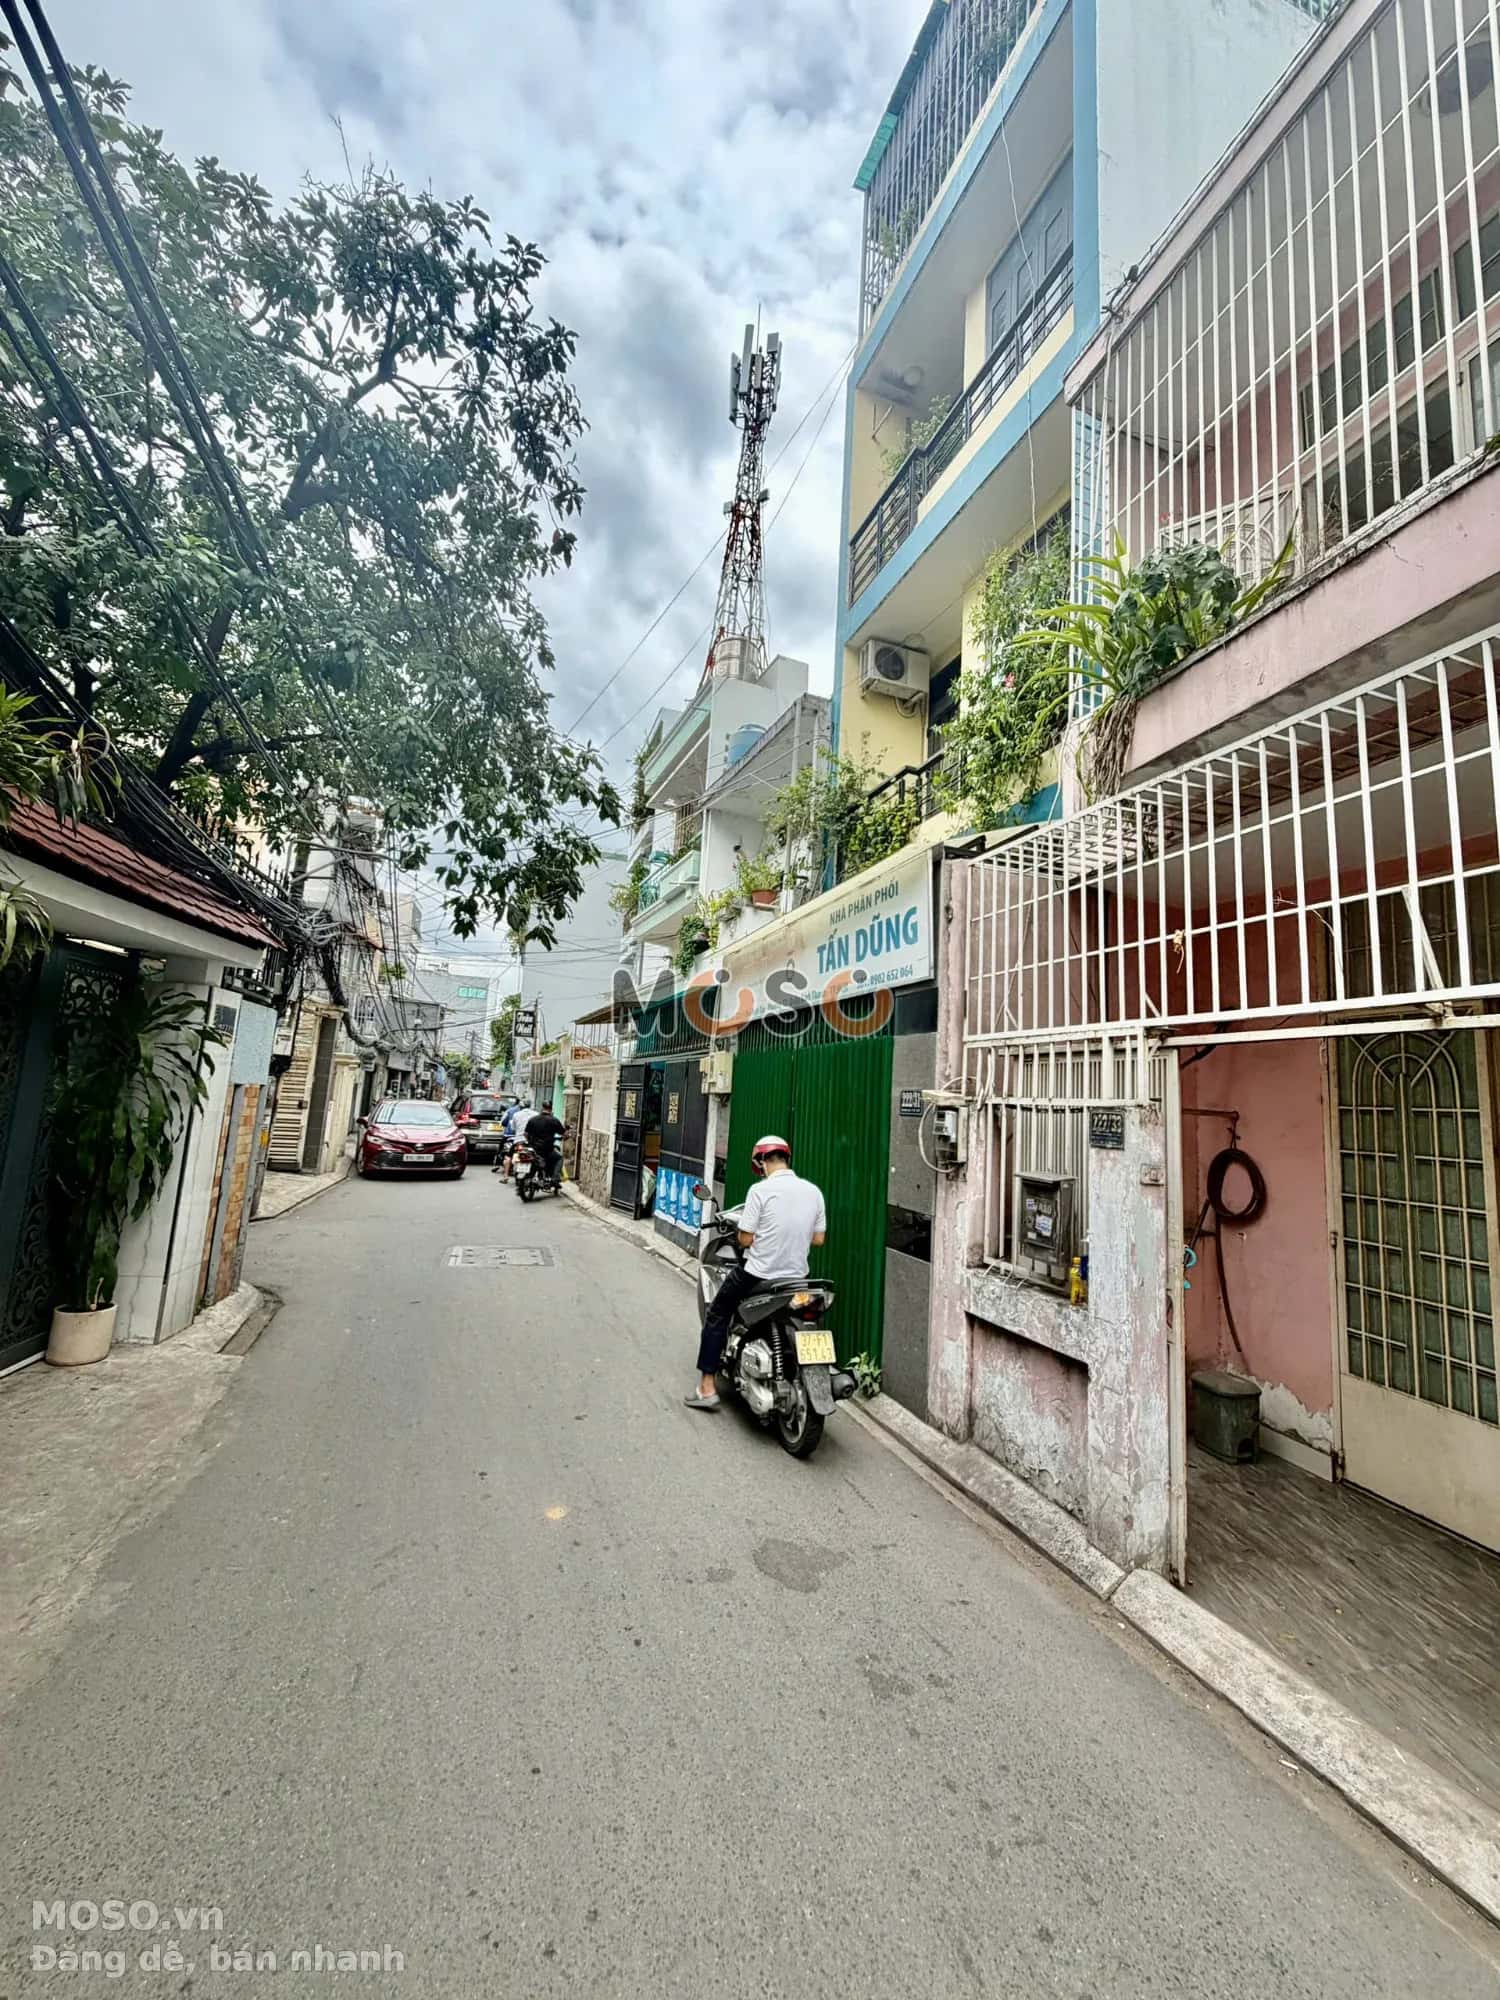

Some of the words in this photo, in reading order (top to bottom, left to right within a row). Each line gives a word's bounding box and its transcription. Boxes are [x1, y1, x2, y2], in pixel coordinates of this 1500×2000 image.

[830, 905, 846, 925] NHÀ
[848, 894, 873, 918] PHÂN
[874, 878, 899, 906] PHỐI
[817, 928, 849, 974] TẤN
[855, 906, 919, 963] DŨNG
